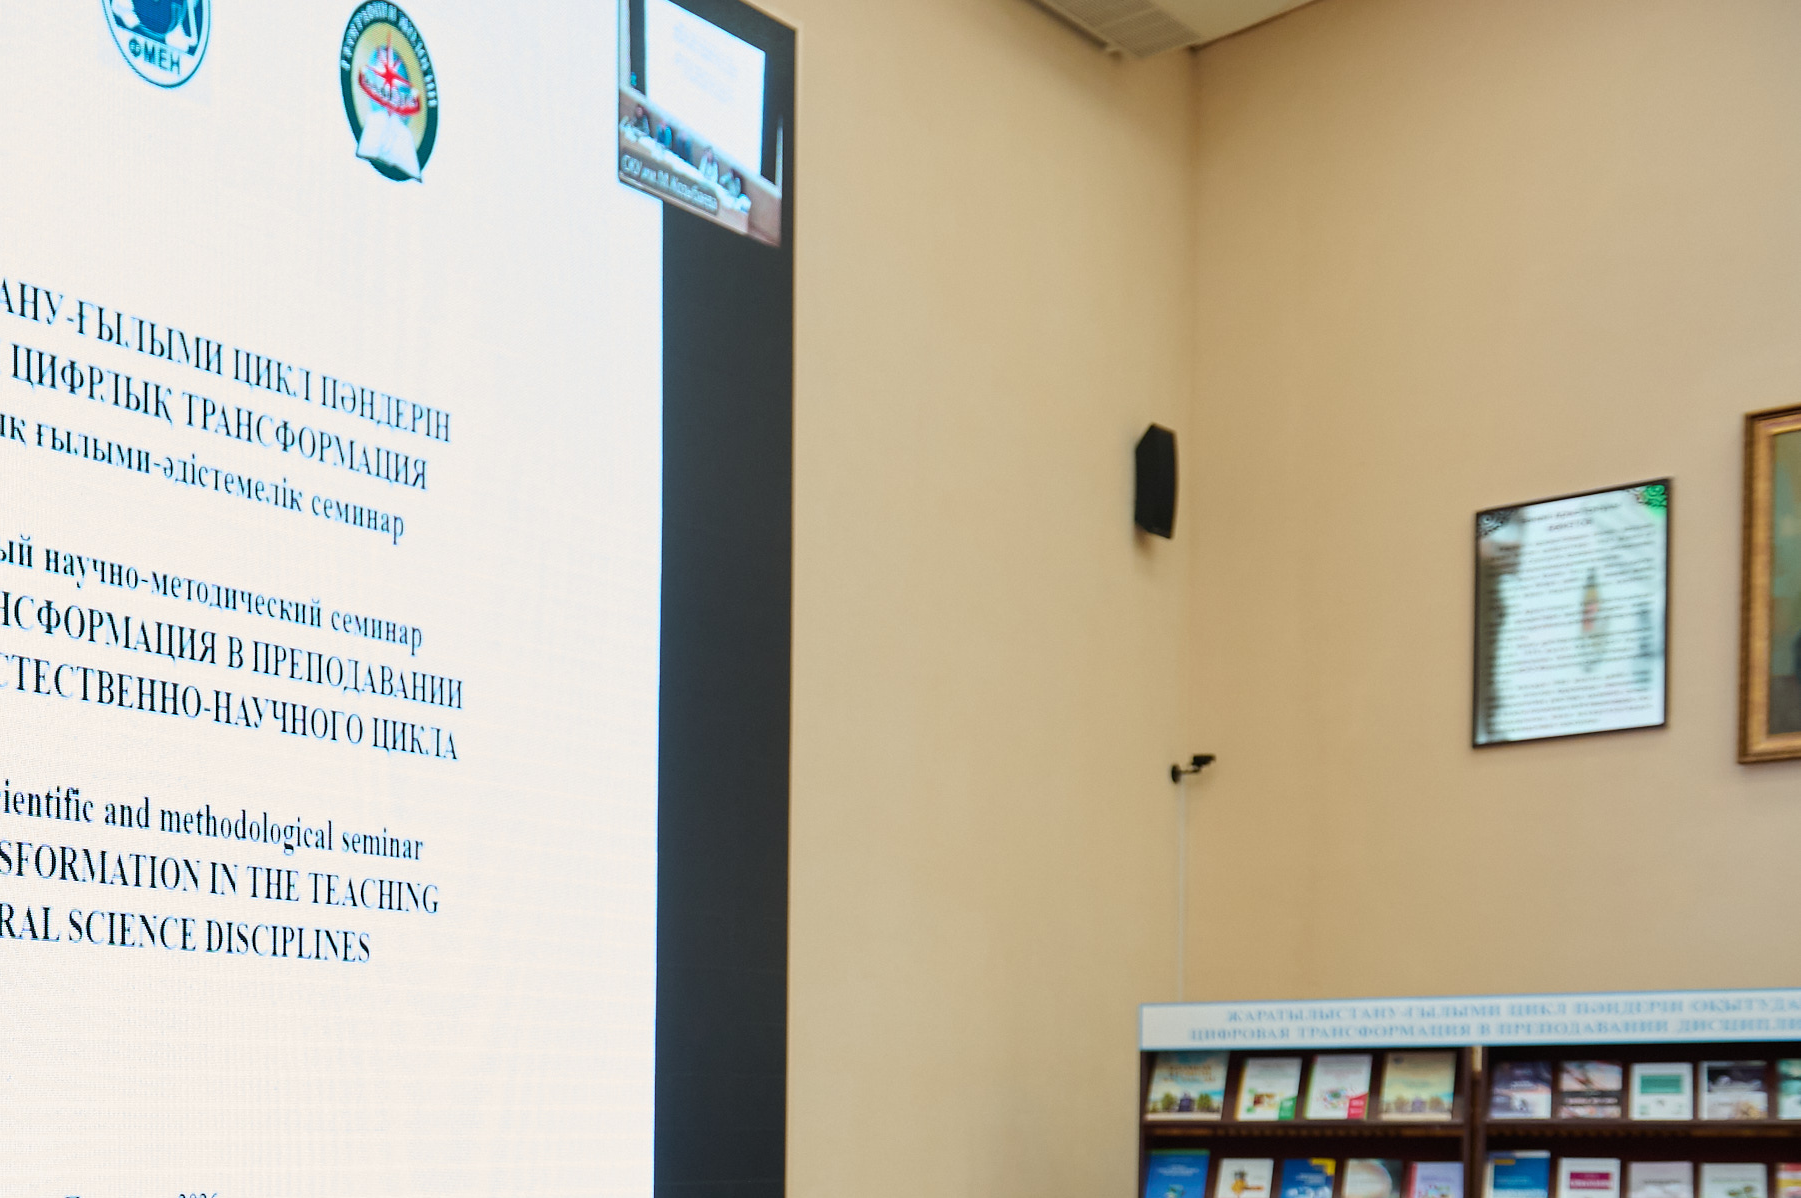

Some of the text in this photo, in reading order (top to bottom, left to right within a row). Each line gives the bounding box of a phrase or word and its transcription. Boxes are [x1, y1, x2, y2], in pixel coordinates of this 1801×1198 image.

[11, 343, 173, 424] ЦИФРЛЫҚ
[182, 393, 426, 490] ТРАНСФОРМАЦИЯ
[233, 348, 311, 402] ЦИКЛ
[321, 375, 450, 442] ПӘНДЕРІН
[36, 423, 303, 512] ғылыми-әдістемелік
[311, 496, 404, 545] семинар
[45, 548, 321, 628] научно-методический
[330, 611, 422, 656] семинар
[227, 635, 244, 669] В
[252, 640, 462, 709] ПРЕПОДАВАНИИ
[372, 717, 458, 760] ЦИКЛА
[104, 796, 150, 830] and
[160, 804, 333, 854] methodological
[342, 827, 424, 861] seminar
[209, 861, 238, 896] IN
[246, 865, 300, 902] THE
[308, 872, 439, 914] TEACHING
[68, 910, 197, 952] SCIENCE
[205, 919, 370, 963] DISCIPLINES
